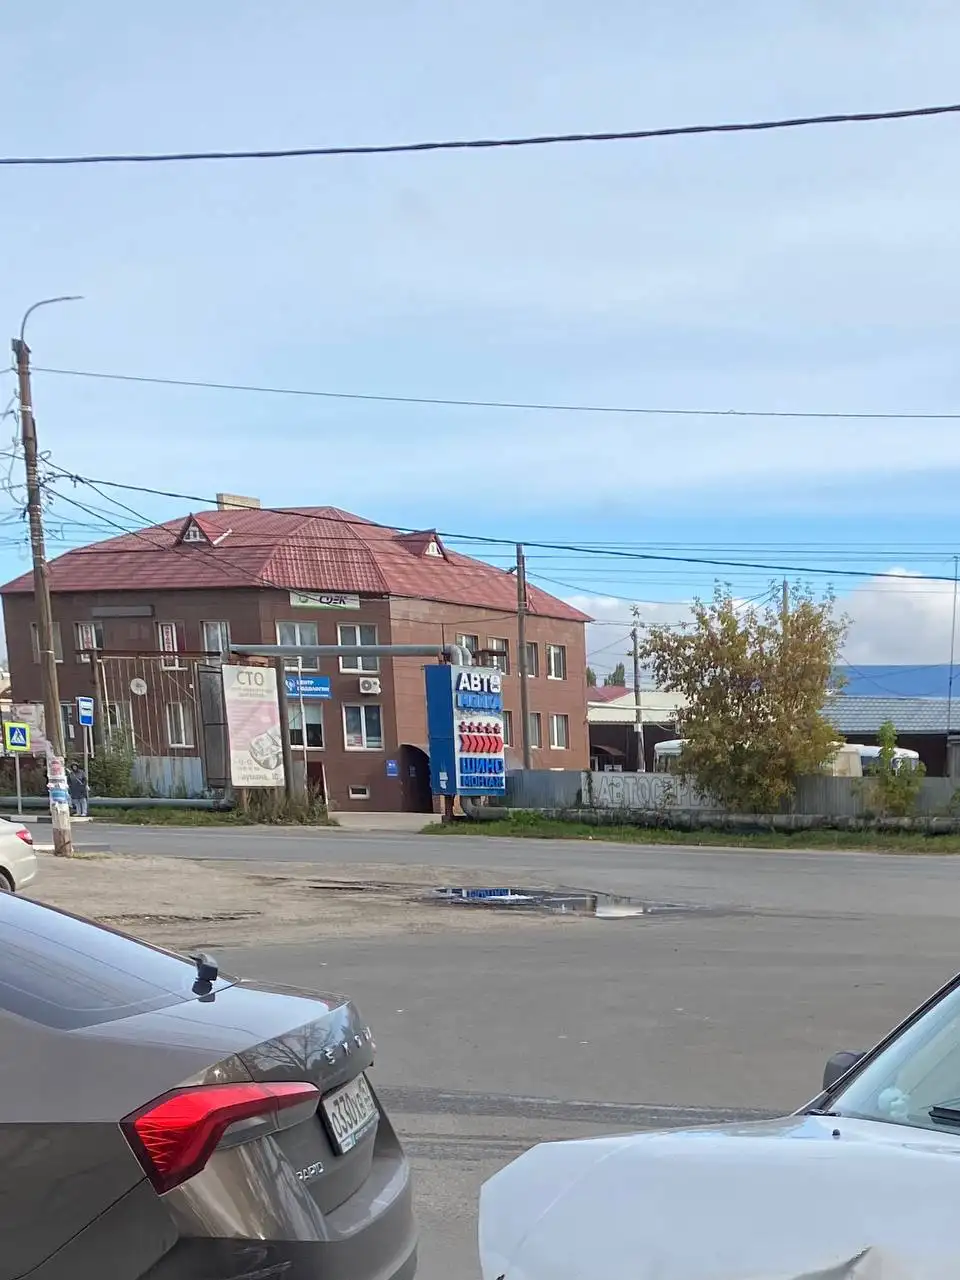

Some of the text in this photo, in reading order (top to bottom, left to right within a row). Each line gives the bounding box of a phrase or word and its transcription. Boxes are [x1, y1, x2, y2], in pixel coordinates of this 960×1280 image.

[236, 671, 265, 687] СТО
[459, 672, 501, 693] АВТО
[462, 775, 504, 788] МОНТАЖ
[295, 1161, 324, 1181] RAPID
